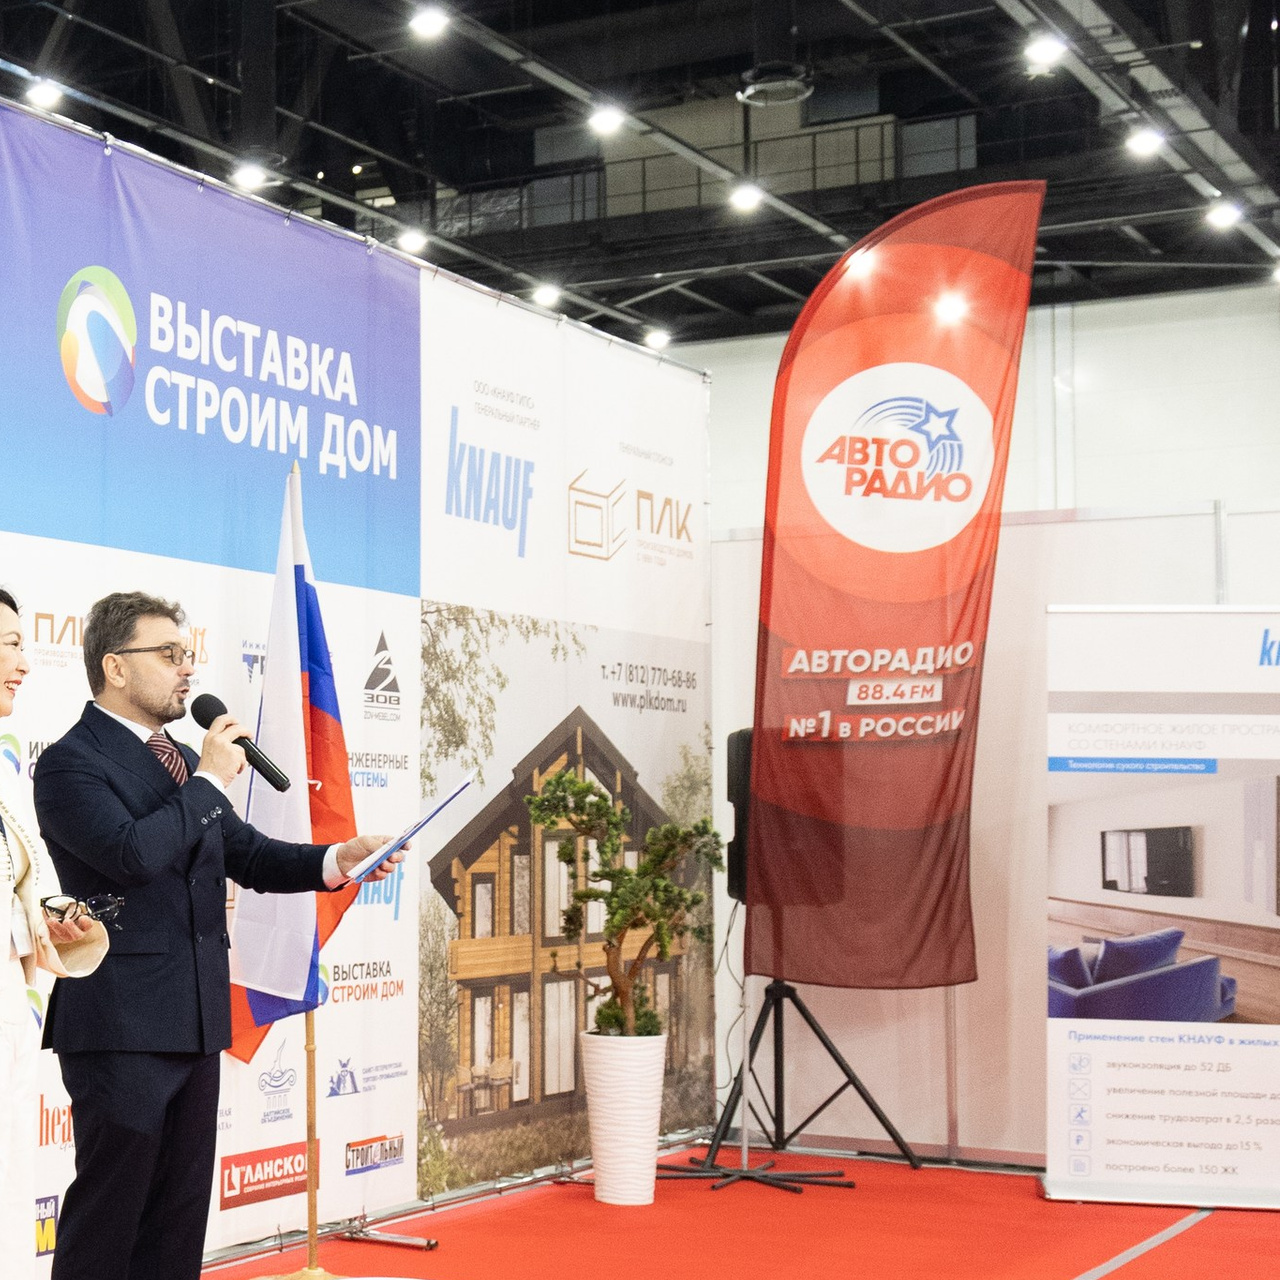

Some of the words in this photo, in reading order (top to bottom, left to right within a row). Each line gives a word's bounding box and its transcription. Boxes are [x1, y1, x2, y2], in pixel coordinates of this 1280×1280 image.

[149, 293, 358, 406] ВЫСТАВКА
[144, 365, 308, 460] СТРОИМ
[319, 418, 398, 480] ДОМ
[815, 435, 920, 469] АВТО
[845, 466, 973, 502] РАДИО
[636, 489, 693, 543] ПЛК
[788, 641, 974, 675] АВТОРАДИО
[611, 663, 622, 681] +7
[625, 663, 649, 687] (812)
[651, 666, 697, 689] 770-68-86
[613, 689, 687, 714] www.plkdom.ru
[857, 684, 906, 700] 88.4
[910, 685, 935, 699] FM
[789, 710, 832, 739] №1
[859, 710, 965, 738] РОССИИ
[1068, 723, 1164, 735] КОМФОРТНОЕ
[1161, 739, 1206, 751] КНАУФ
[348, 752, 409, 770] НЖЕНЕРНЫЕ
[333, 960, 391, 982] ВЫСТАВКА
[332, 982, 378, 1003] СТРОИМ
[381, 980, 404, 1001] ДОМ
[1068, 1030, 1145, 1043] Применение
[1149, 1035, 1175, 1043] стен
[1178, 1034, 1225, 1045] КНАУФ
[1106, 1060, 1181, 1071] звукоизоляция
[1183, 1063, 1197, 1072] до
[1200, 1062, 1213, 1072] 52
[1106, 1086, 1166, 1096] увеличение
[1169, 1088, 1218, 1098] полезной
[1221, 1090, 1267, 1100] площади
[1106, 1111, 1156, 1121] снижение
[1106, 1137, 1184, 1148] экономическая
[1239, 1140, 1251, 1151] 15
[243, 1153, 308, 1184] ЛАНСКО
[1105, 1163, 1160, 1174] построено
[1163, 1164, 1195, 1173] более
[1199, 1164, 1218, 1175] 150
[1220, 1165, 1239, 1175] ЖК
